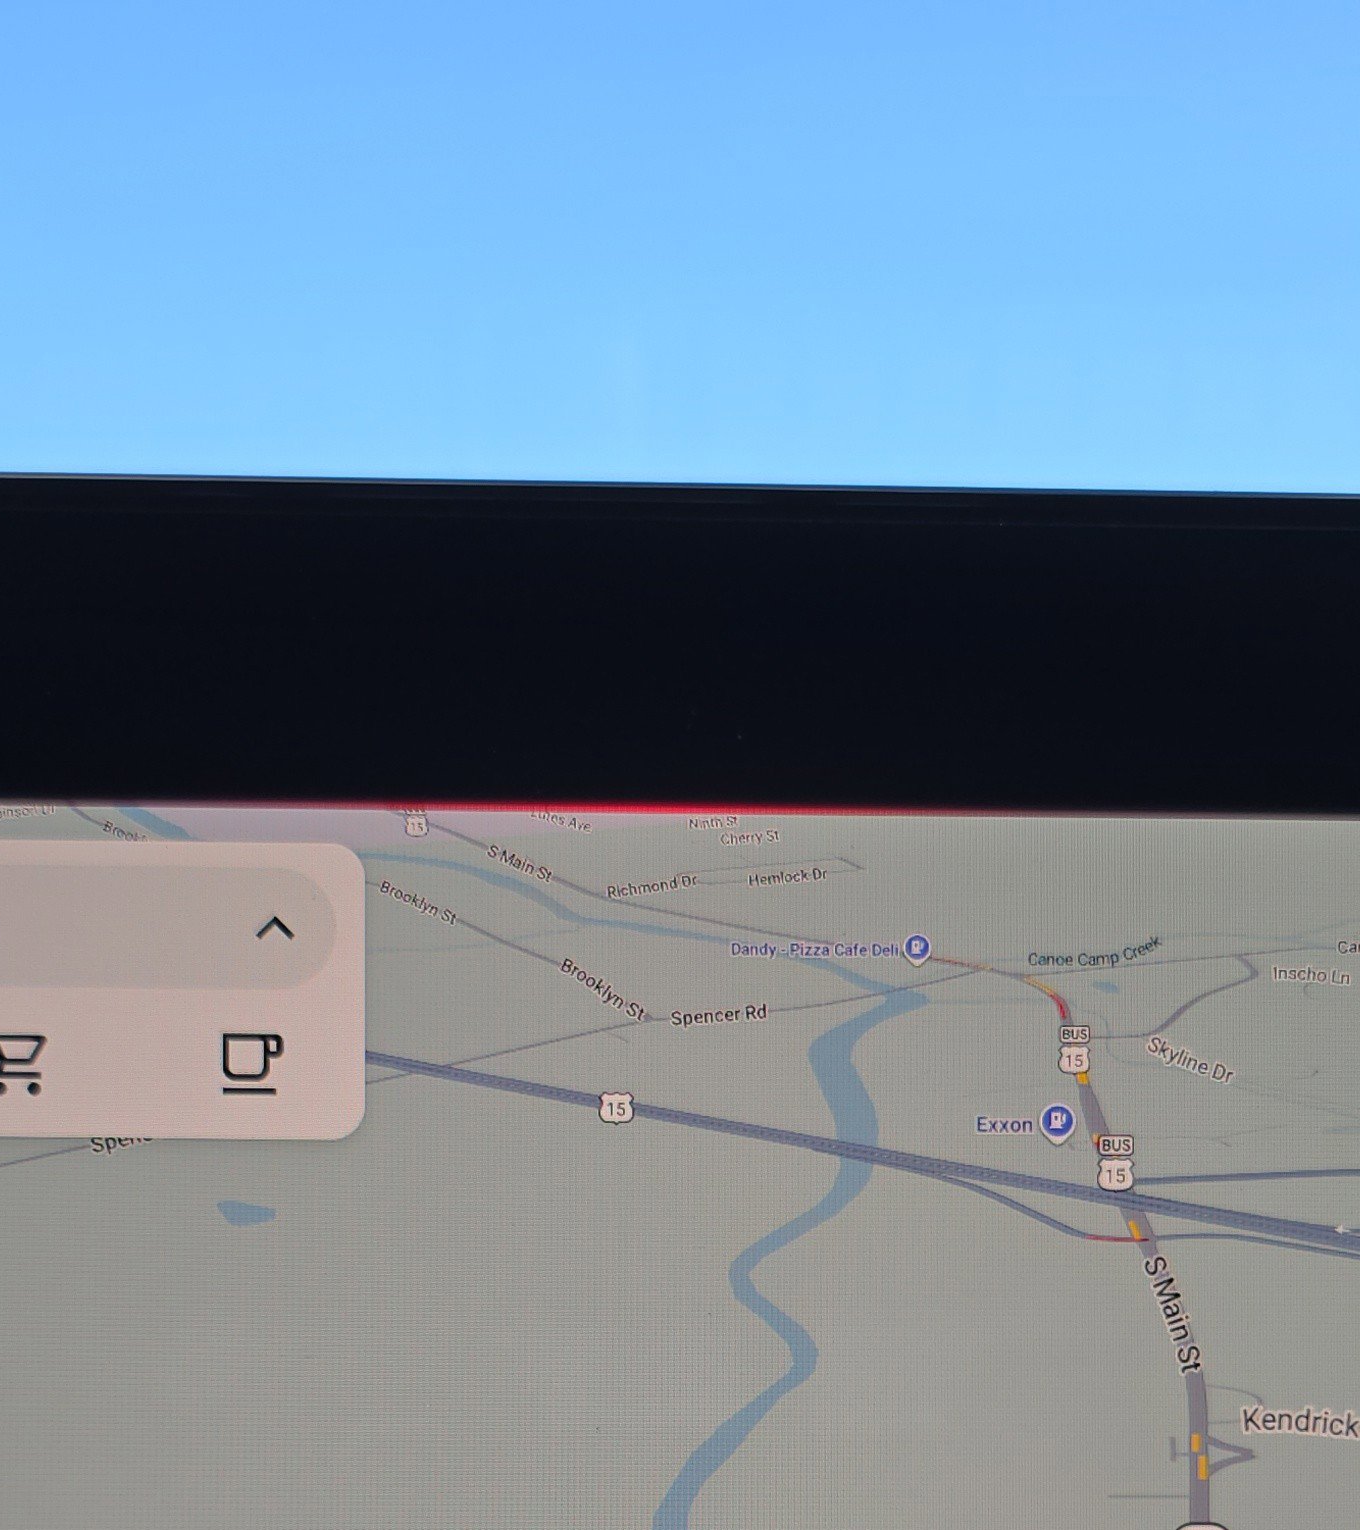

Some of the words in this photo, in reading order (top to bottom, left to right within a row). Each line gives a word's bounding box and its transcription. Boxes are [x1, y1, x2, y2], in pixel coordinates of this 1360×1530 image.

[410, 821, 424, 833] 15
[568, 817, 592, 833] Ave
[726, 815, 738, 827] St
[720, 831, 763, 846] Cherry
[766, 829, 780, 843] St
[487, 845, 499, 858] S
[500, 848, 535, 875] Main
[537, 866, 552, 882] St
[607, 878, 678, 898] Richmond
[681, 874, 697, 888] Dr
[748, 870, 810, 887] Hemlock
[813, 868, 828, 881] Dr
[380, 880, 439, 917] Brooklyn
[441, 908, 457, 925] St
[731, 943, 777, 958] Dandy
[791, 943, 830, 957] Pizza
[834, 943, 868, 957] Cafe
[871, 943, 899, 957] Deli
[1028, 953, 1073, 966] Canoe
[1077, 951, 1119, 967] Camp
[1122, 936, 1163, 962] Creek
[1331, 970, 1350, 986] Ln
[561, 958, 636, 1011] Brooklyn
[626, 1001, 646, 1021] St
[671, 1007, 741, 1027] Spencer
[745, 1004, 768, 1020] Rd
[1061, 1028, 1089, 1041] BUS
[1065, 1054, 1084, 1069] 15
[1147, 1036, 1209, 1076] Skyline
[1211, 1062, 1234, 1085] Dr
[607, 1102, 627, 1117] 15
[976, 1116, 1034, 1134] Exxon
[91, 1137, 153, 1154] Spe
[1101, 1138, 1132, 1154] BUS
[1105, 1167, 1126, 1185] 15
[1144, 1256, 1168, 1277] S
[1154, 1277, 1190, 1342] Main
[1176, 1344, 1202, 1375] St
[1242, 1407, 1360, 1438] Kendrick
